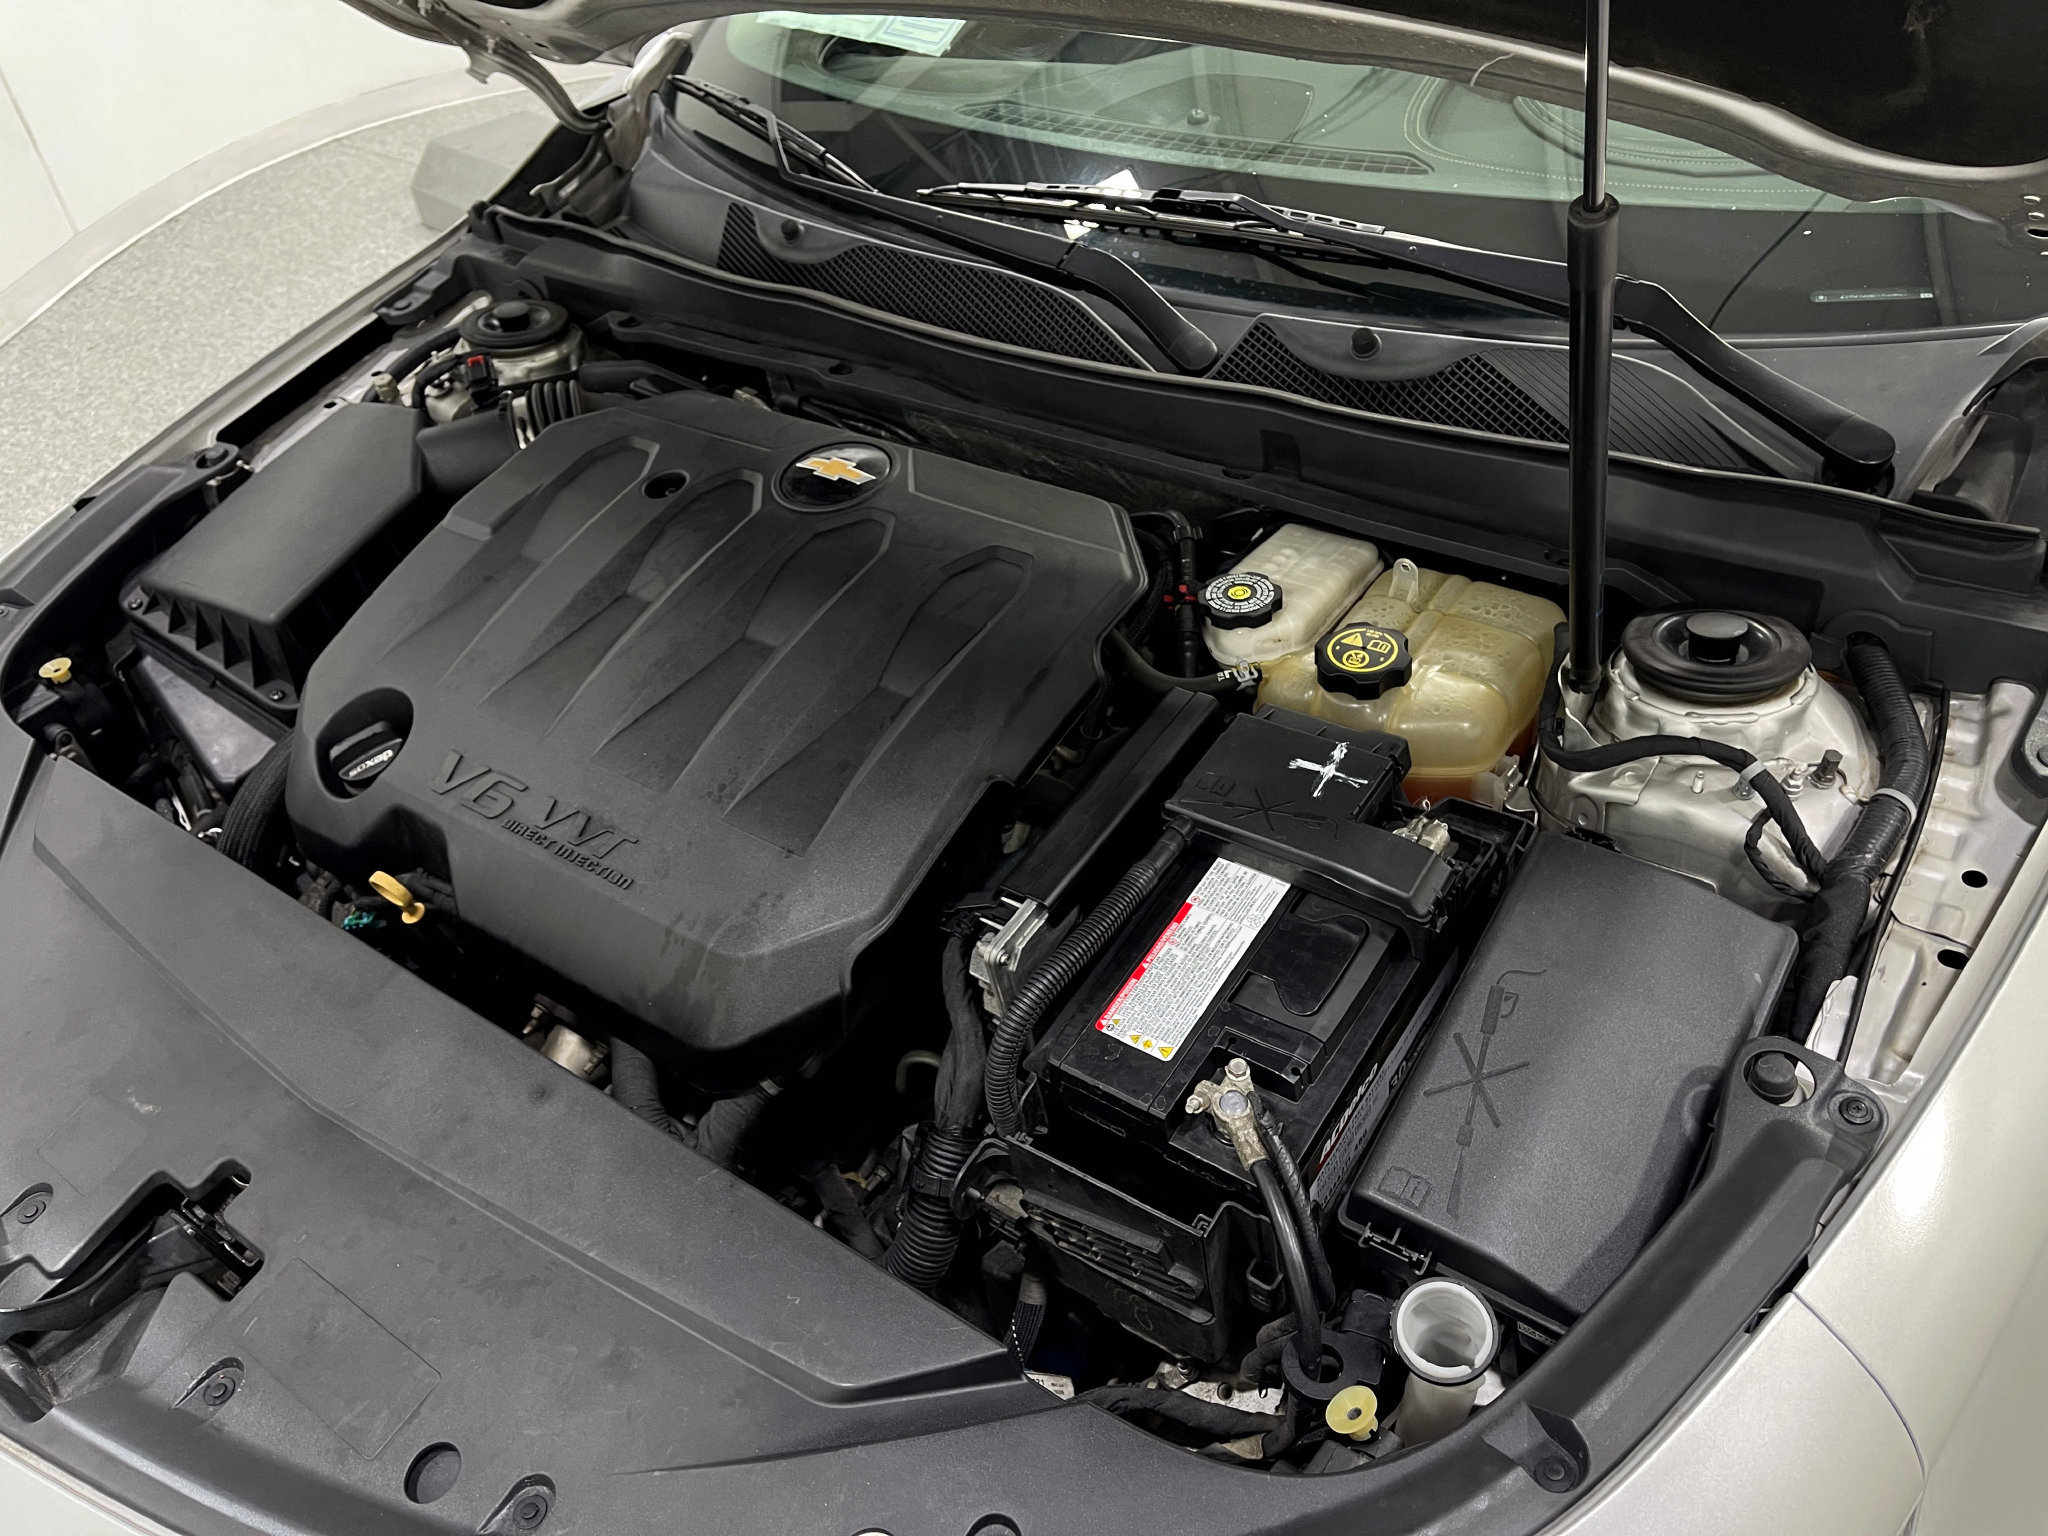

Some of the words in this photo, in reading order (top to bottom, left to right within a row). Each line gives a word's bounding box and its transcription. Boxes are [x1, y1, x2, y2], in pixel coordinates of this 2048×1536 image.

[348, 749, 394, 778] dexos
[432, 750, 530, 819] V6
[534, 796, 639, 859] VVT
[501, 818, 557, 850] DIRECT
[553, 843, 635, 890] INJECTION
